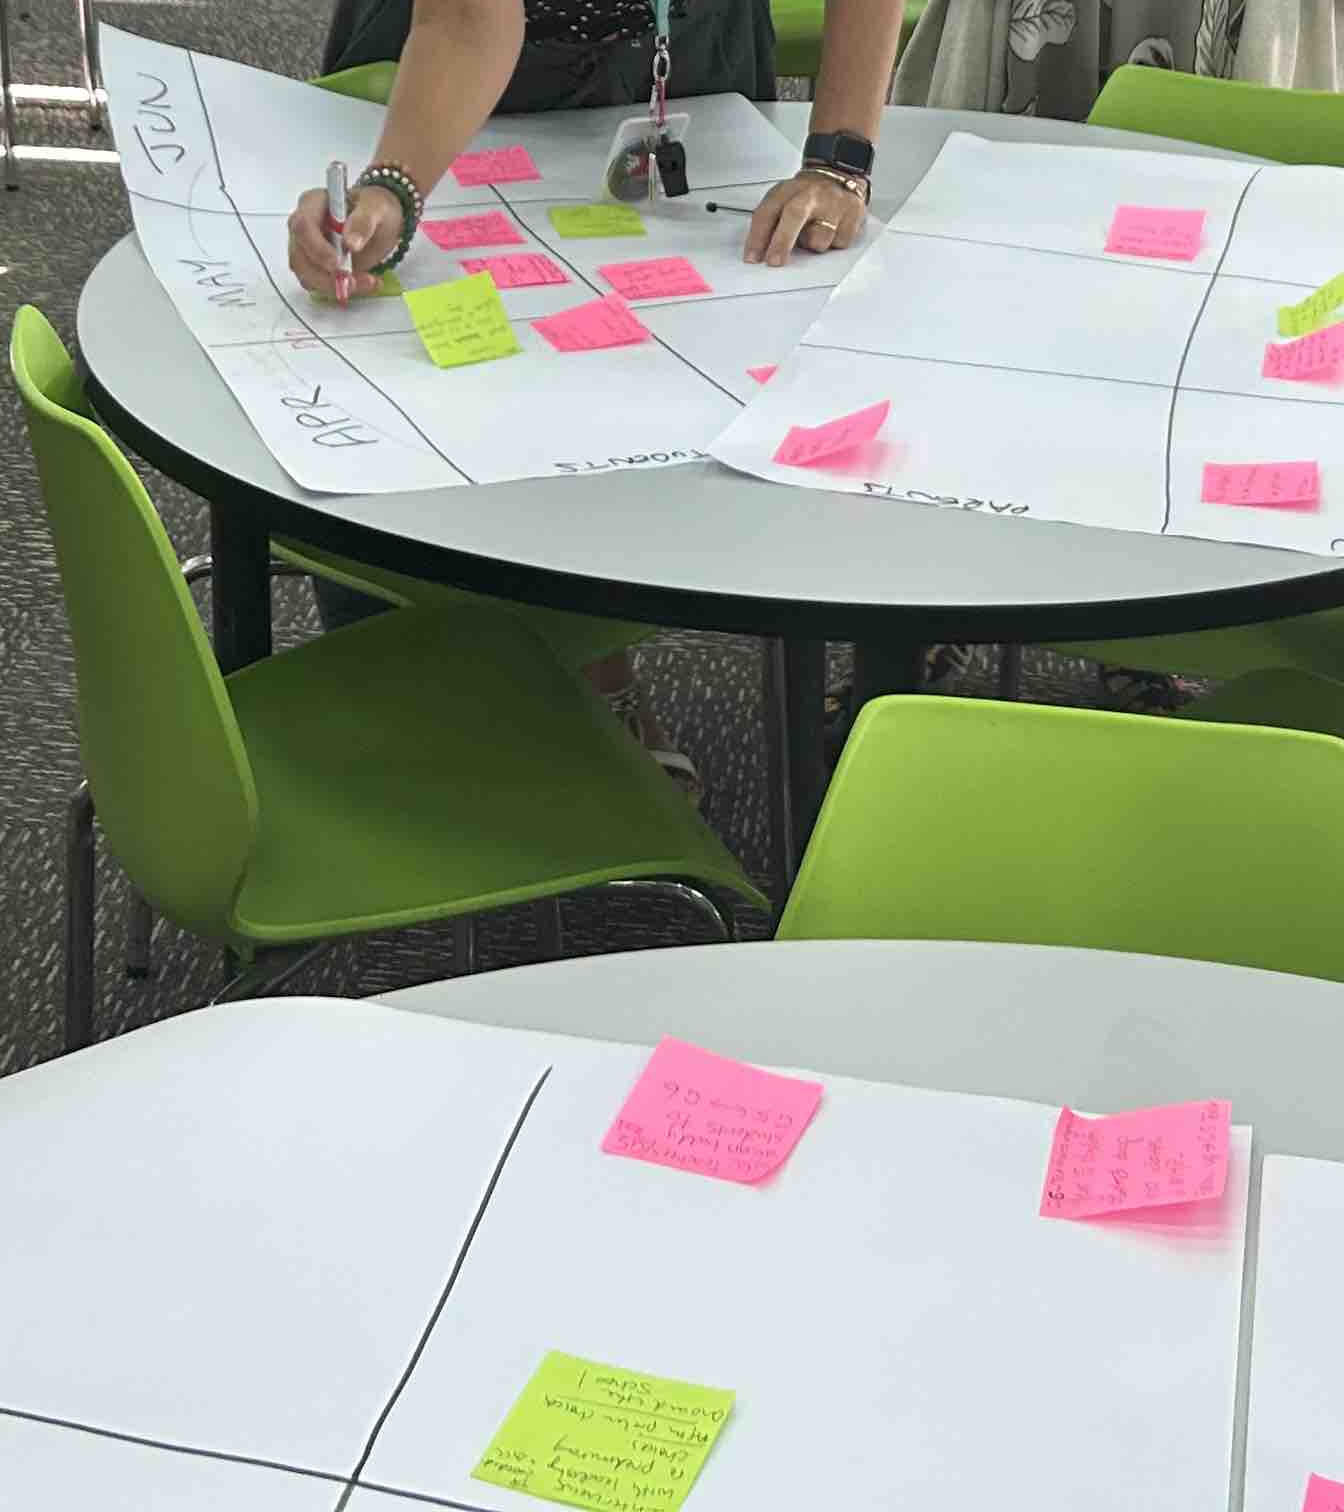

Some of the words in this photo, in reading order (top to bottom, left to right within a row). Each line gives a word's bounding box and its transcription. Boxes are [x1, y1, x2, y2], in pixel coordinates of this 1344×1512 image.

[133, 71, 186, 176] JUN
[176, 256, 258, 308] MAY
[280, 383, 379, 449] APR
[553, 447, 710, 474] TUDENTS
